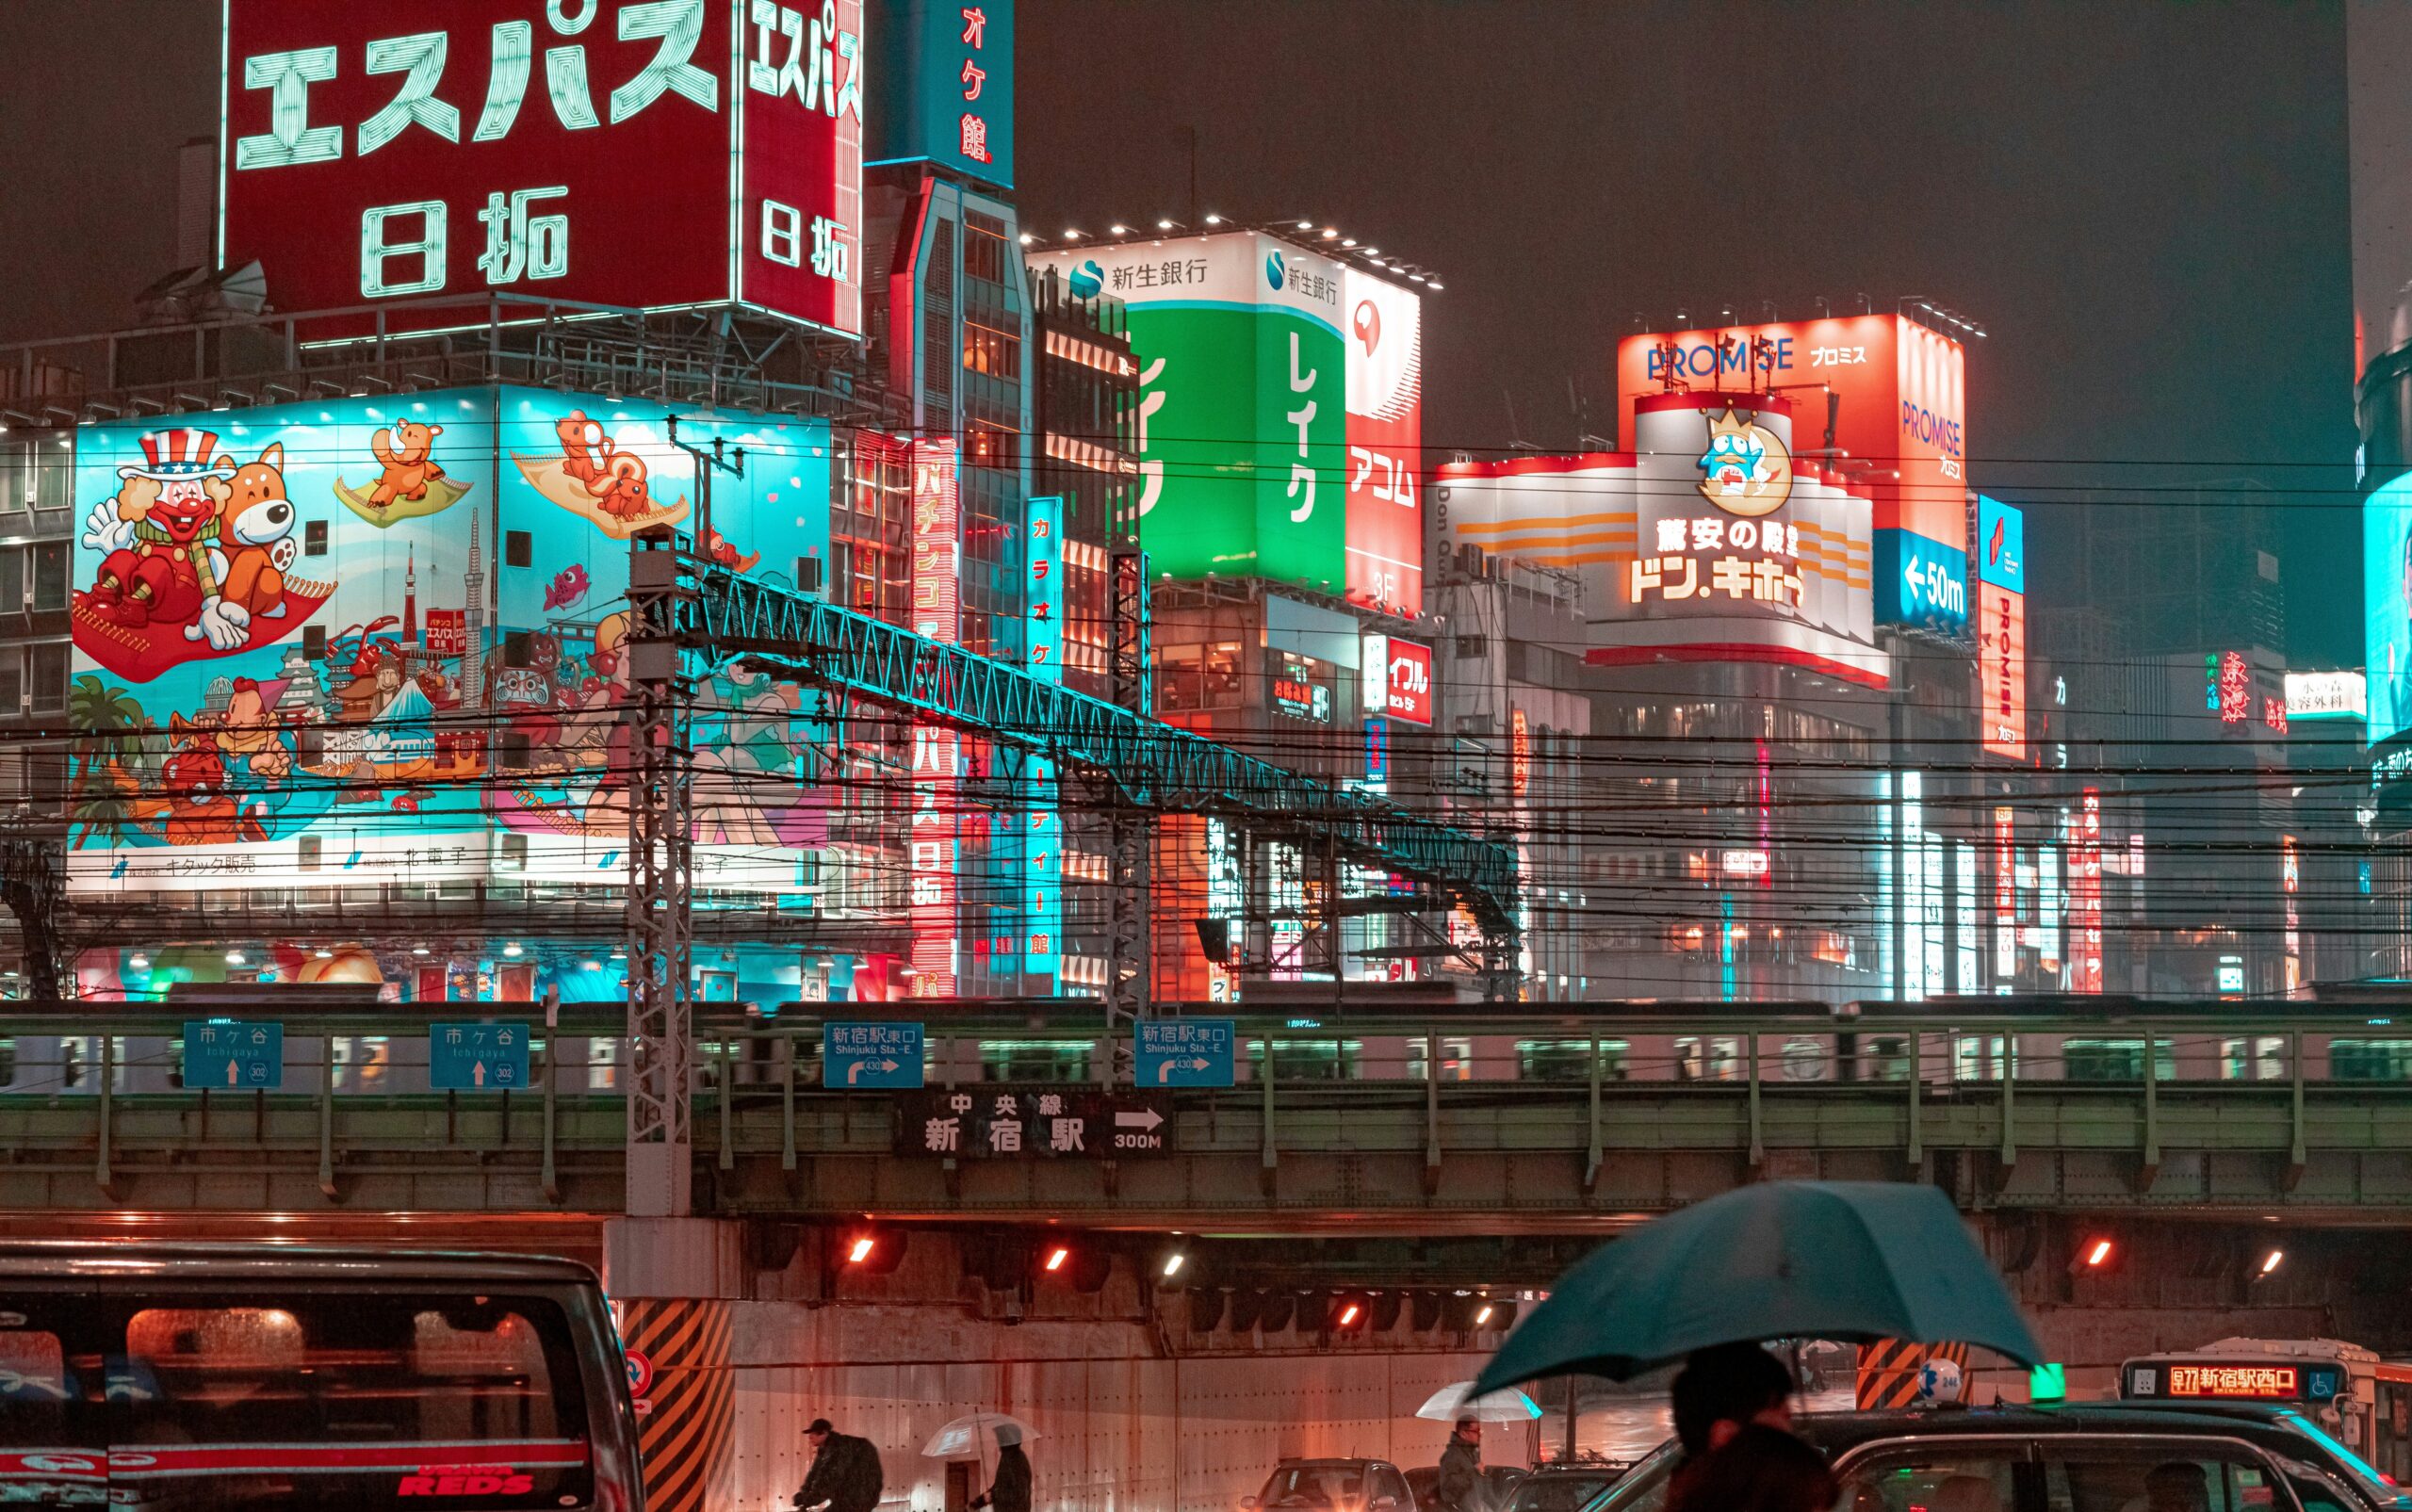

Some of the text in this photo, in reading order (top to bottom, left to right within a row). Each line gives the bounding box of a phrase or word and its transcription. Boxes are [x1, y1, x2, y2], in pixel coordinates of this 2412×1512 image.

[749, 0, 862, 127] エスパス
[236, 0, 719, 171] エスパス
[361, 186, 568, 299] 日拓
[761, 198, 849, 283] 日拓
[1111, 258, 1209, 291] 新生銀行
[1288, 267, 1338, 306] 新生銀行
[1647, 336, 1795, 381] PROMSE
[1810, 345, 1868, 368] プロミス
[1286, 331, 1318, 524] レイク
[1902, 399, 1961, 457] PROMISE
[1349, 445, 1417, 510] アコム
[1939, 453, 1962, 480] プロミス
[1373, 571, 1394, 603] 3F
[1927, 561, 1964, 615] 50m
[1998, 596, 2012, 718] PROMISE
[832, 1027, 916, 1044] 新宿駅東口
[1142, 1025, 1225, 1043] 新宿駅東口
[453, 1048, 505, 1058] Ichigaya
[836, 1045, 876, 1055] Shinjuku
[1145, 1044, 1186, 1054] Shinjuku
[252, 1068, 265, 1077] 302
[497, 1068, 512, 1078] 302
[866, 1062, 880, 1071] 430
[1177, 1060, 1191, 1069] 430
[951, 1094, 1062, 1115] 中央線
[925, 1117, 1084, 1151] 新宿駅
[1115, 1134, 1161, 1148] 300M
[2200, 1368, 2294, 1389] 新宿駅西口
[398, 1475, 534, 1496] REDS
